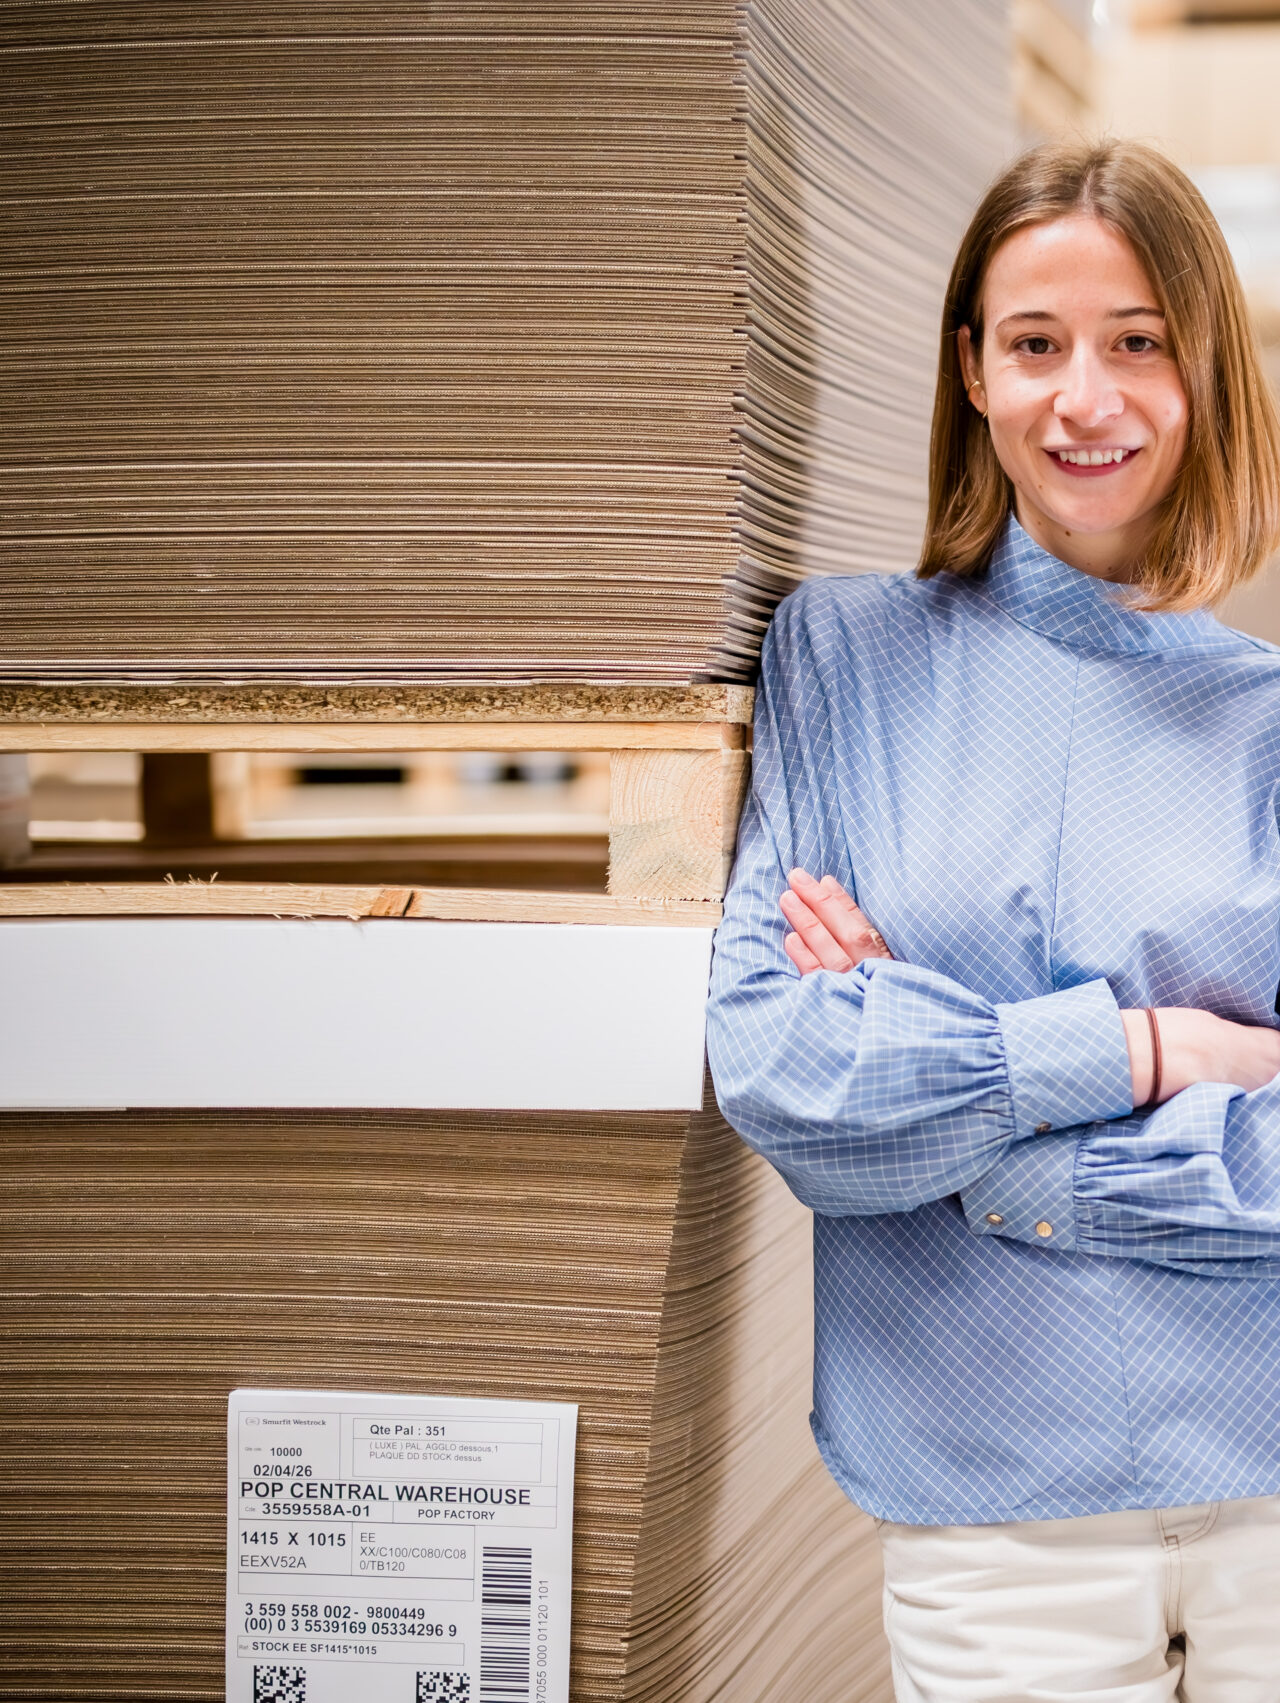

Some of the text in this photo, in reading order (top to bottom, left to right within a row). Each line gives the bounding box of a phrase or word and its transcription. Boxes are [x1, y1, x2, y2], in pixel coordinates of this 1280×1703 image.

[370, 1424, 391, 1435] Qte
[395, 1425, 414, 1436] Pal
[425, 1426, 446, 1437] 351
[270, 1447, 303, 1457] 10000
[375, 1441, 397, 1450] LUXE
[425, 1442, 457, 1452] AGGLO
[369, 1451, 404, 1460] PLAQUE
[422, 1452, 452, 1461] STOCK
[253, 1464, 313, 1477] 02/04/26
[241, 1481, 531, 1505] POP CENTRAL WAREHOUSE
[262, 1502, 370, 1518] 3559558A-01
[418, 1509, 496, 1521] POP FACTORY
[241, 1531, 279, 1546] 1415
[307, 1532, 347, 1547] 1015
[360, 1532, 376, 1543] EE
[360, 1546, 467, 1560] XX/C100/C080/C08
[240, 1555, 307, 1569] EEXV52A
[359, 1560, 405, 1572] 0/TB120
[538, 1580, 549, 1600] 101
[245, 1603, 253, 1616] 3
[258, 1603, 286, 1617] 559
[291, 1604, 319, 1618] 558
[366, 1606, 426, 1620] 9800449
[244, 1617, 458, 1637] (00) 0 3 5539169 05334296 9
[537, 1604, 549, 1642] 01120
[252, 1641, 290, 1652] STOCK
[292, 1642, 307, 1653] EE
[536, 1644, 548, 1667] 000
